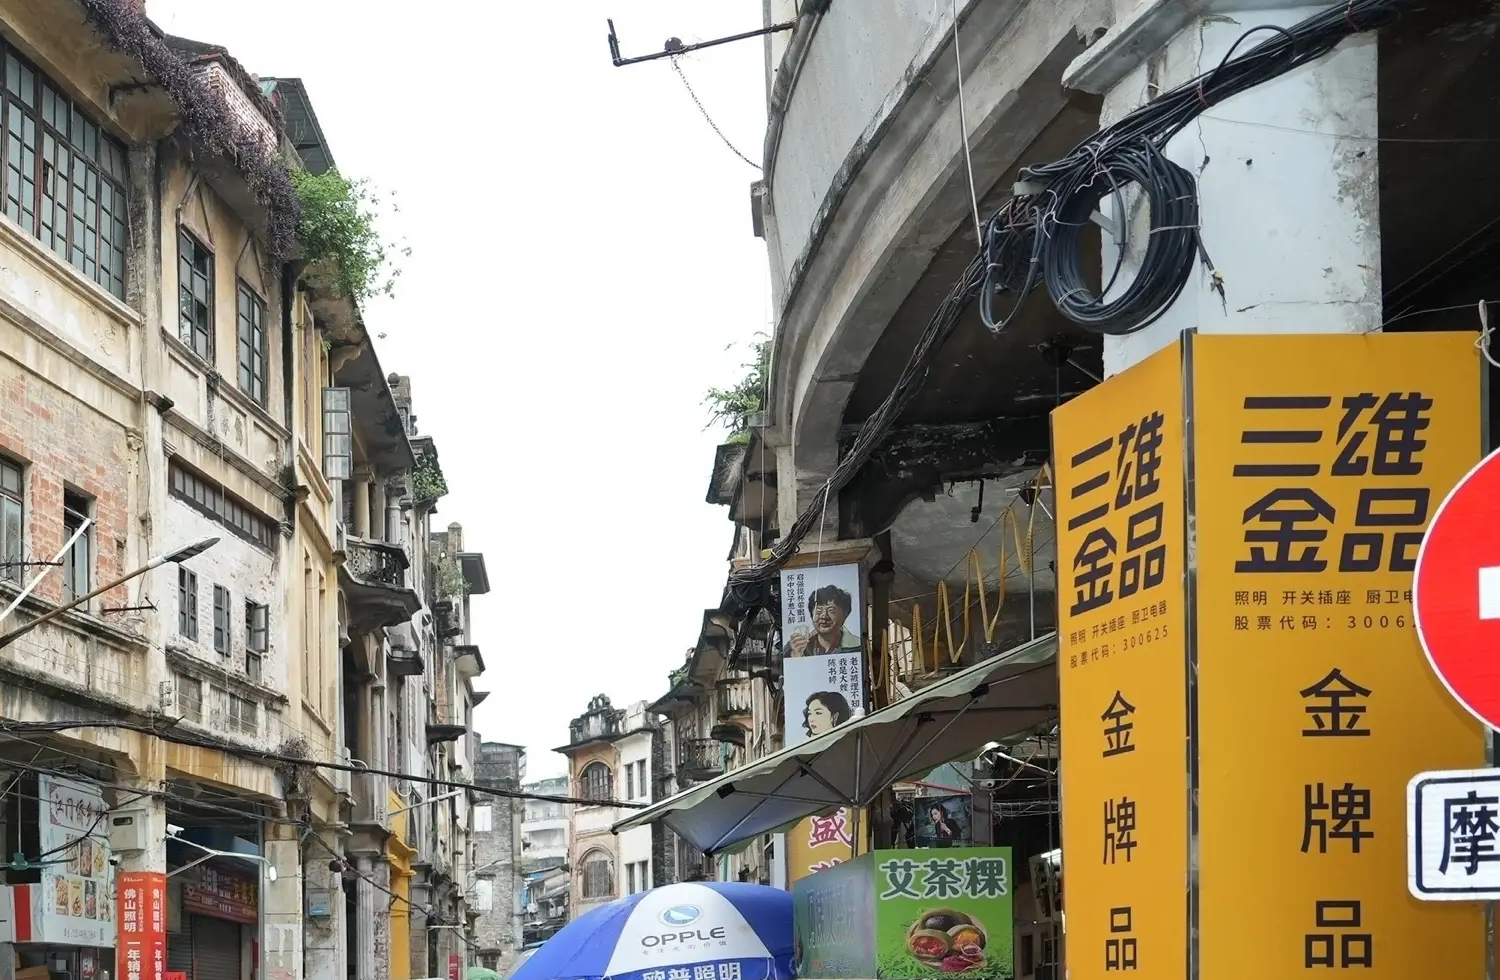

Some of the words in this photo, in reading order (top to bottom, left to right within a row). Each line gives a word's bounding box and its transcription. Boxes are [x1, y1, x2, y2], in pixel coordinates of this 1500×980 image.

[1233, 391, 1434, 478] 三雄
[1068, 411, 1165, 531] 三雄
[1233, 487, 1432, 574] 金品
[1069, 501, 1167, 617] 金品
[1234, 590, 1268, 606] 照明
[1282, 590, 1352, 606] 开关插座
[1069, 631, 1087, 647] 照明
[1091, 616, 1127, 640] 开关插座
[879, 858, 1008, 900] 艾茶粿
[124, 889, 136, 932] 佛山照明
[640, 926, 726, 948] OPPLE
